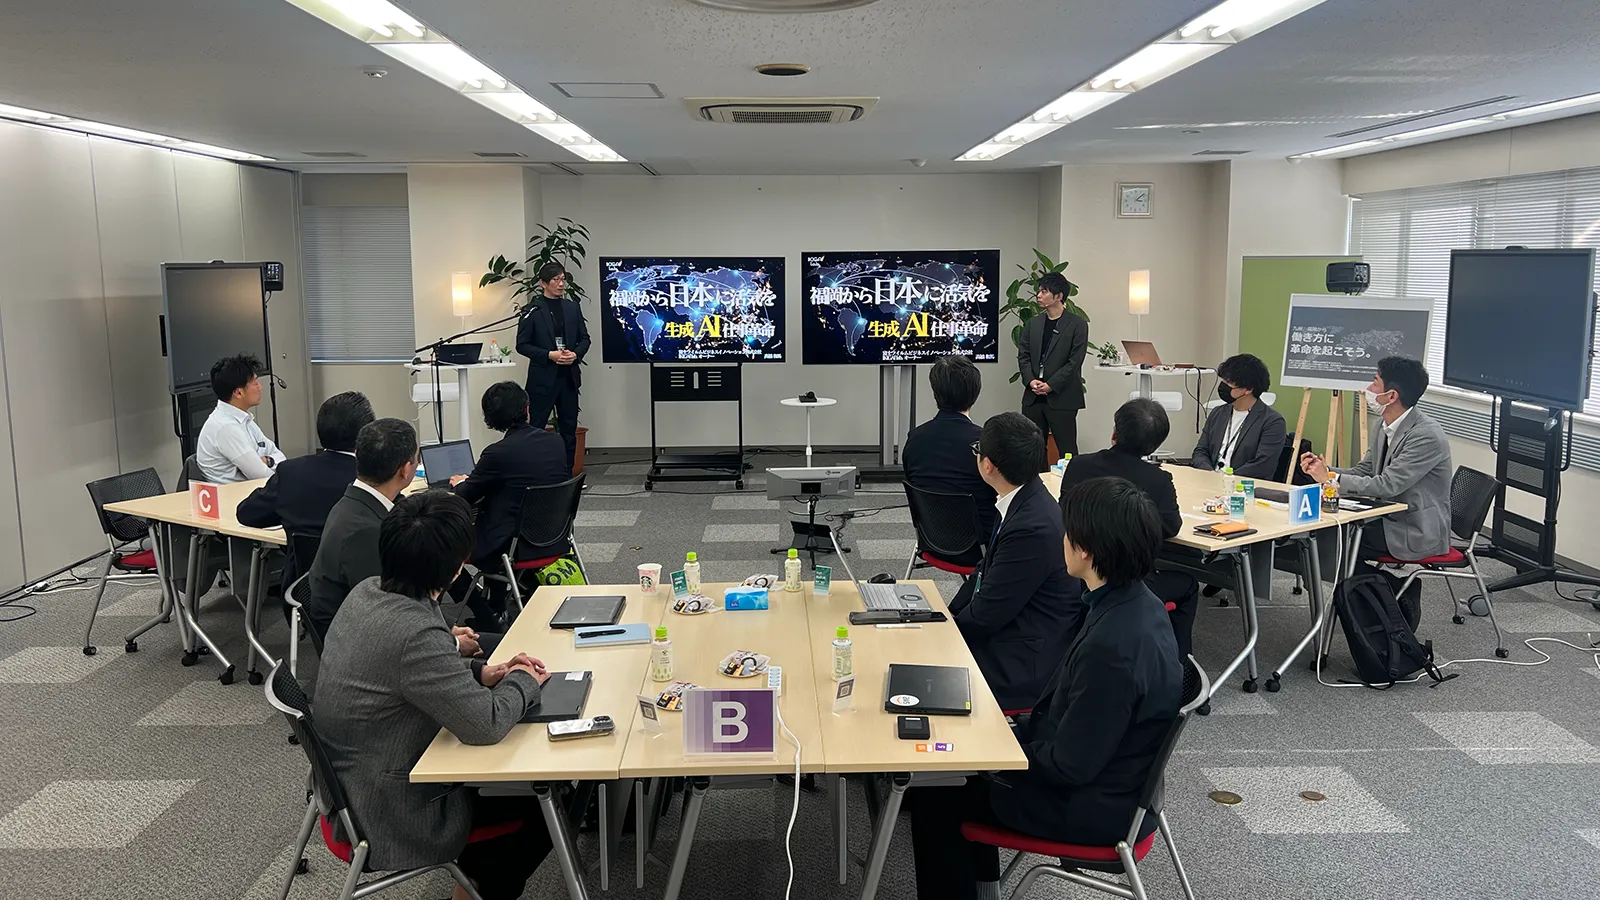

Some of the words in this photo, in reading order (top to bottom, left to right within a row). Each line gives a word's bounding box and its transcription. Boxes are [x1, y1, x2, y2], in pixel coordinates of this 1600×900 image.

[608, 282, 777, 308] 福岡から日本に活気を
[809, 277, 991, 305] 福岡から日本に活気を
[1291, 331, 1335, 344] 働き方に
[1290, 344, 1372, 359] 革命を起こそう。
[199, 489, 212, 513] C
[1297, 493, 1313, 519] A
[712, 701, 749, 744] B
